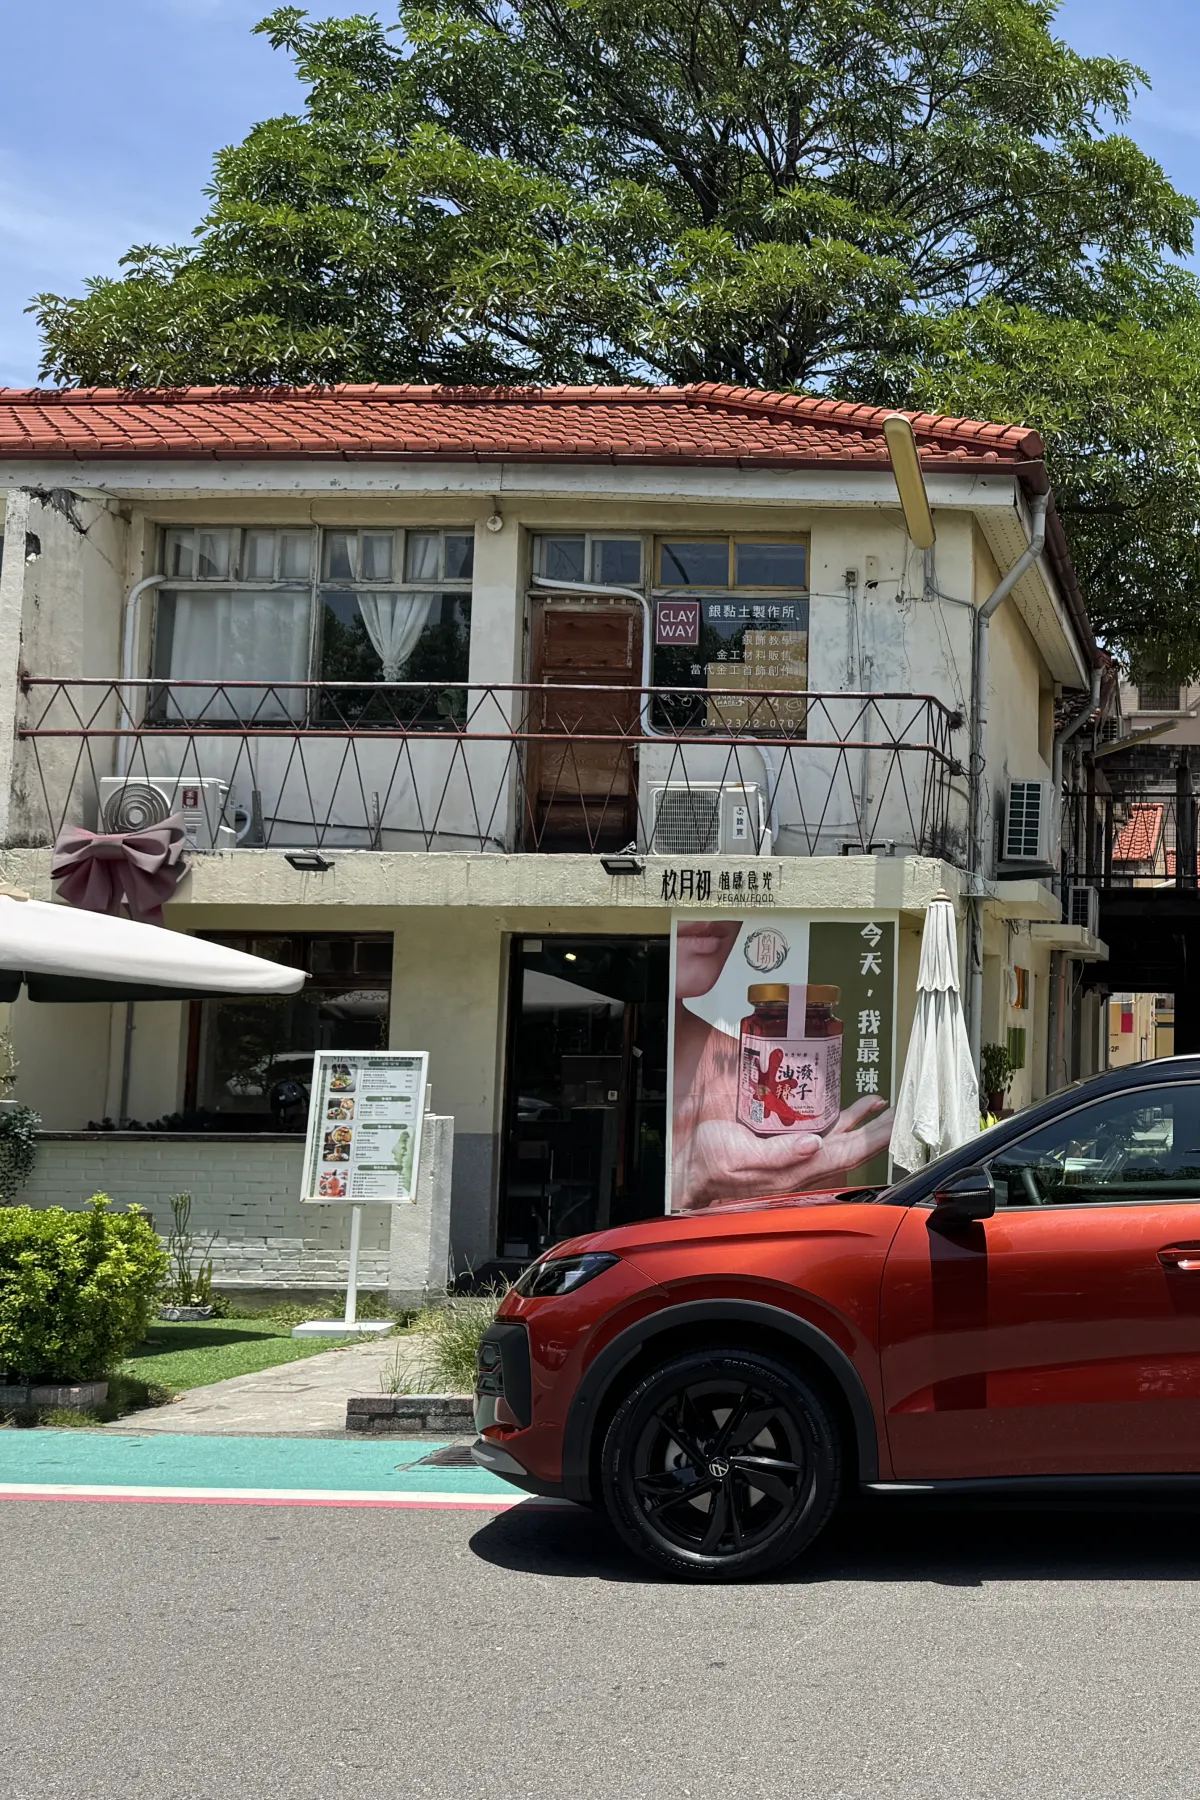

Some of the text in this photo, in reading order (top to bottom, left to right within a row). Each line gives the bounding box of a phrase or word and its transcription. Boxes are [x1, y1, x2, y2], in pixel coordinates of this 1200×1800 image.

[660, 610, 696, 623] CLAY
[708, 604, 796, 618] 銀黏土製作所
[660, 625, 695, 637] WAY
[742, 635, 793, 646] 銀飾教學
[716, 649, 792, 661] 金工材料販售
[690, 663, 791, 676] 當代金工首飾創作
[718, 870, 773, 890] 植感食光
[855, 921, 883, 1094] 今天，我最辣
